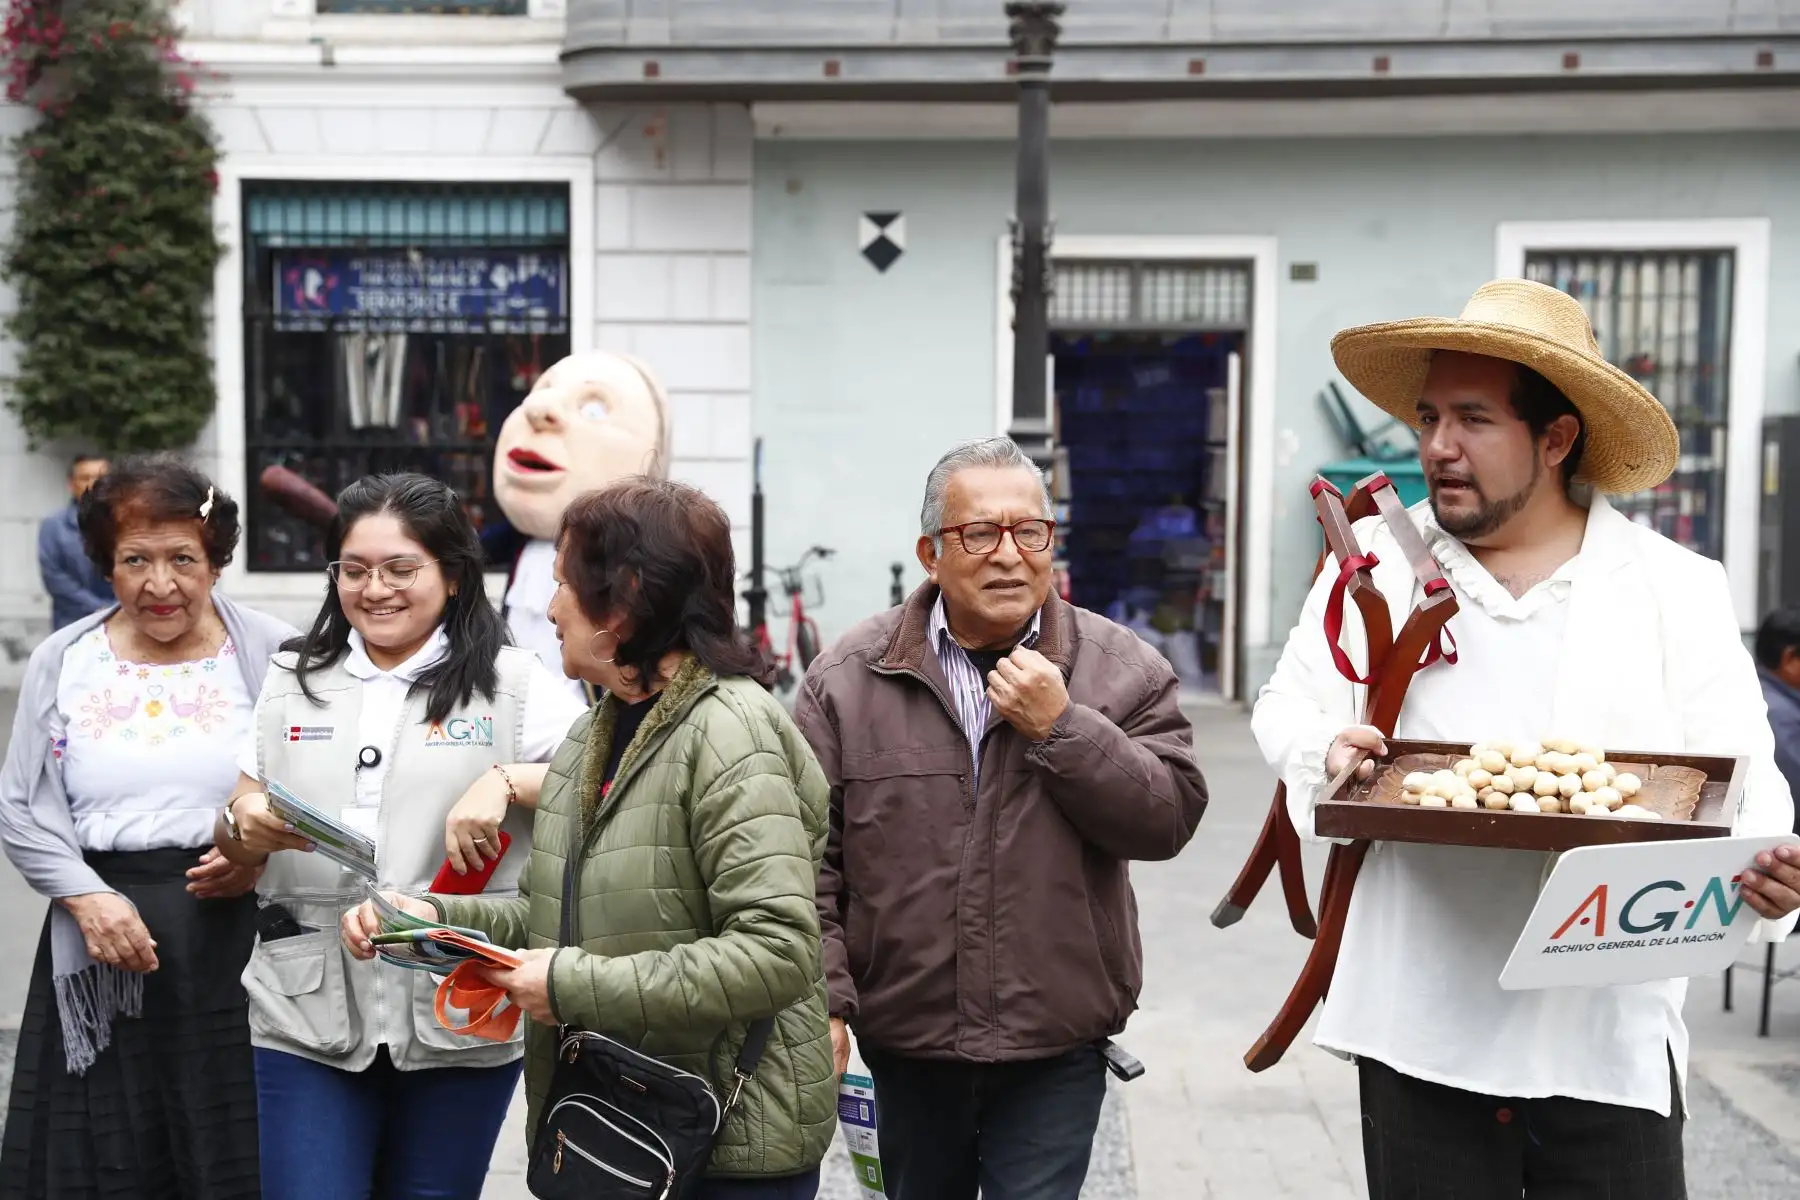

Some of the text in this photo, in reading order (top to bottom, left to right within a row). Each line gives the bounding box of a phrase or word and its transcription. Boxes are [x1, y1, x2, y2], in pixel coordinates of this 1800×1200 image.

[426, 716, 493, 741] AGN
[1550, 876, 1745, 940] AGN
[1542, 931, 1726, 954] ARCHIVO GENERAL DE LA NACIÓN
